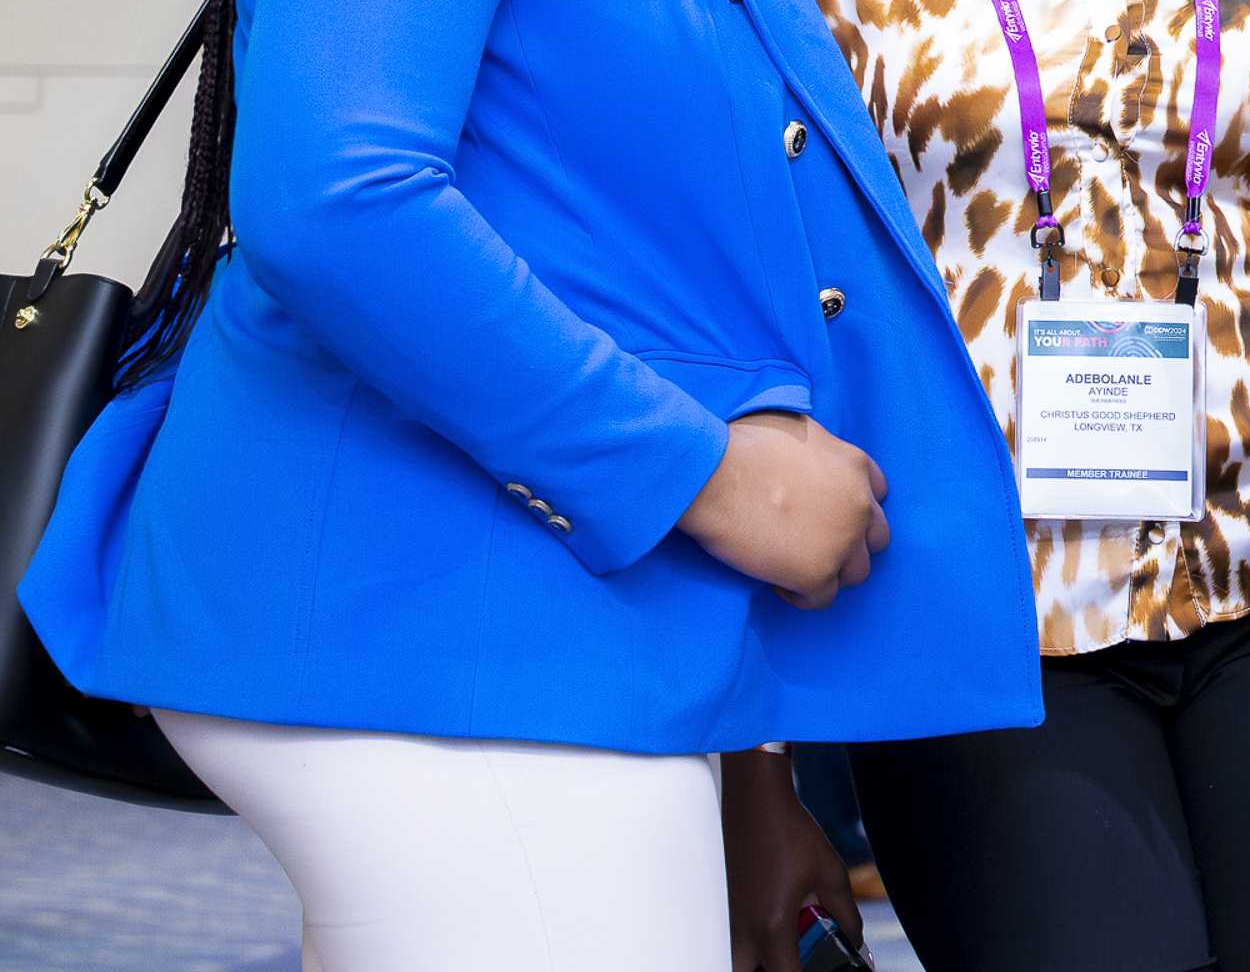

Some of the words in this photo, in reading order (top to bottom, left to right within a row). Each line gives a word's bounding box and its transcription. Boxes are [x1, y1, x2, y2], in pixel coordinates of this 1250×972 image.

[1203, 7, 1216, 41] Entyvio
[1030, 131, 1042, 174] Entyvio
[1193, 142, 1209, 185] Entyvio
[1059, 329, 1081, 337] ABOUT
[1074, 336, 1108, 349] PATH
[1066, 373, 1152, 385] ADEBOLANLE
[1088, 387, 1129, 397] AYINDE
[1040, 410, 1090, 419] CHRISTUS
[1091, 411, 1121, 420] GOOD
[1123, 411, 1176, 421] SHEPHERD
[1074, 423, 1128, 433] LONGVIEW,
[1131, 423, 1143, 432] TX
[1067, 468, 1108, 478] MEMBER
[1109, 469, 1149, 479] TRAINEE
